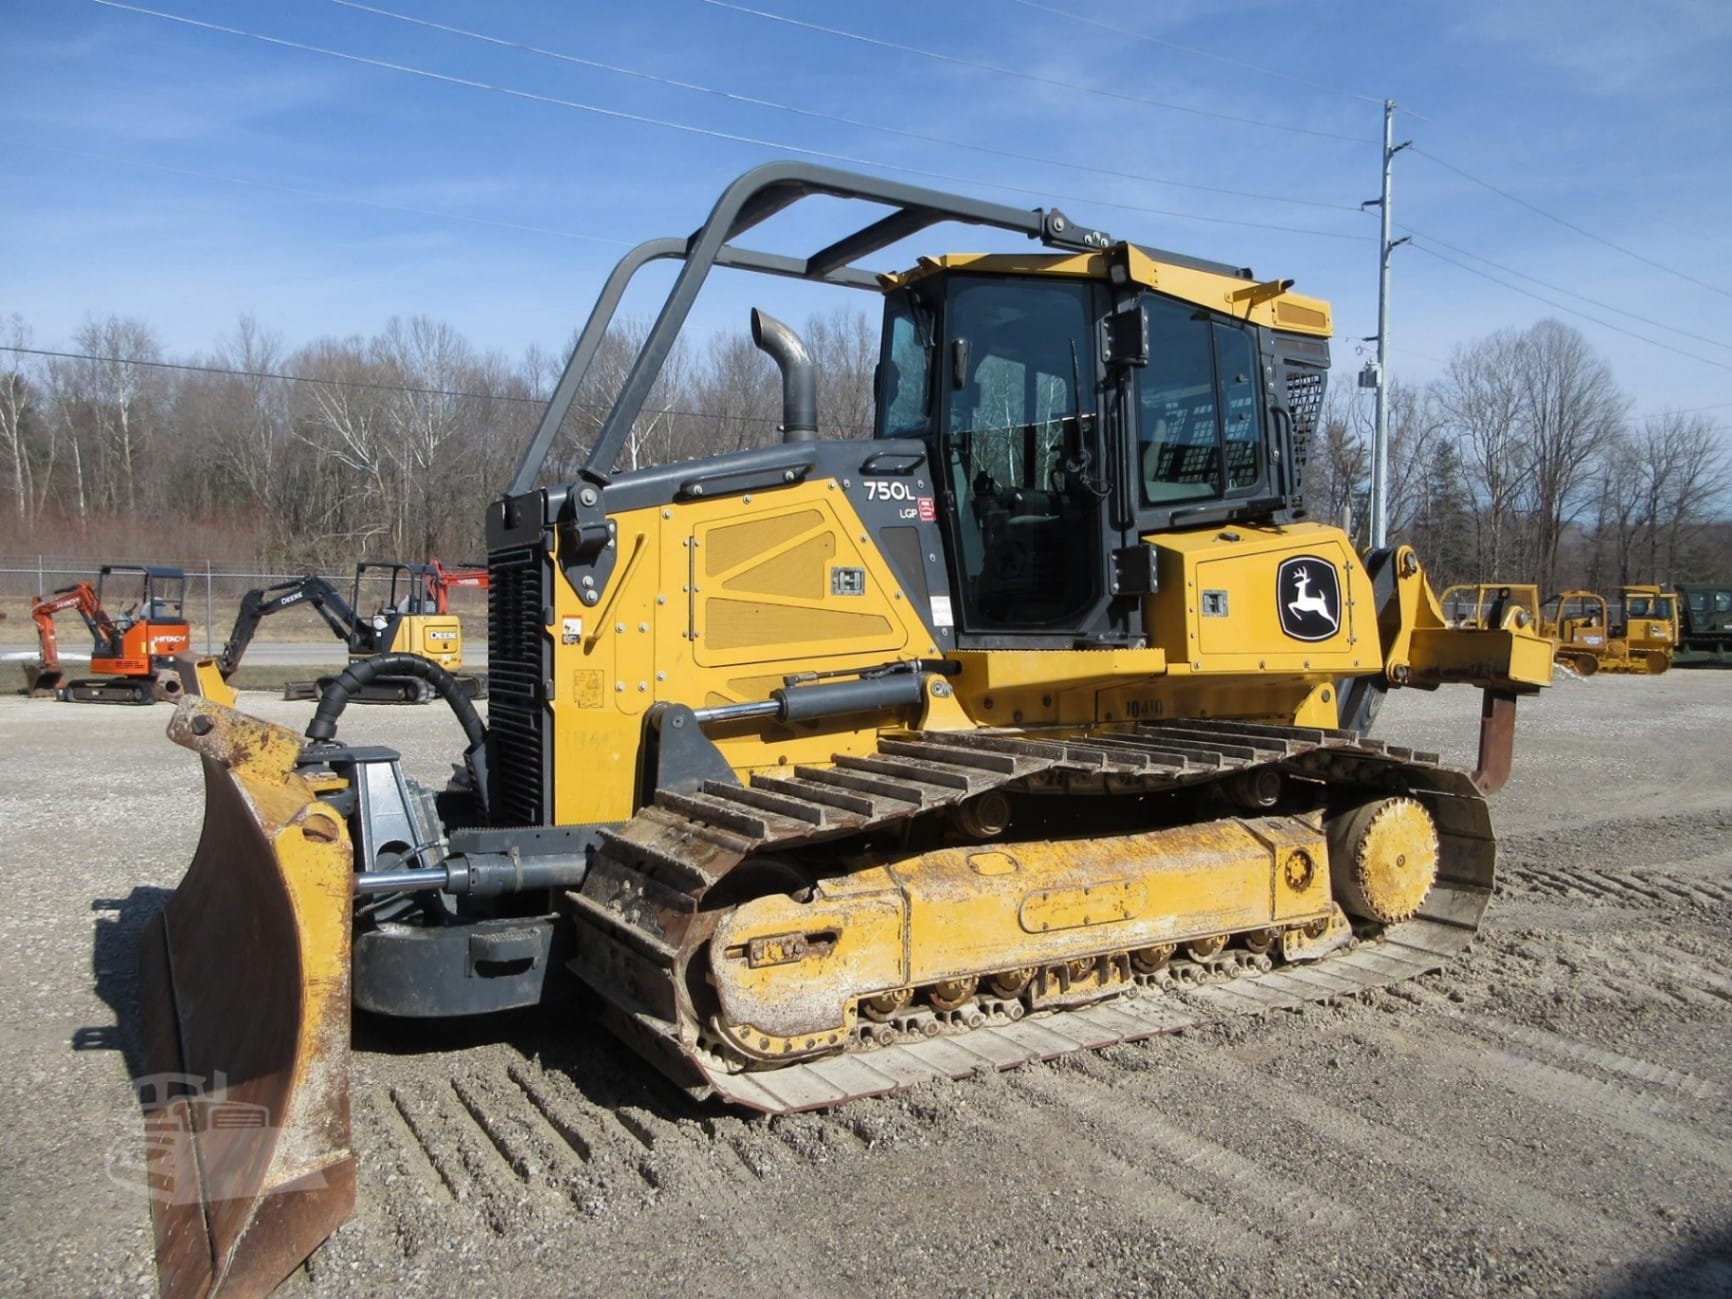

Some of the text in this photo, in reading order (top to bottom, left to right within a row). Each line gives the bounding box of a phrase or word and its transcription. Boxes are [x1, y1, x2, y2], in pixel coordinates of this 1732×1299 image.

[863, 481, 916, 500] 750L
[899, 508, 918, 519] LGP
[280, 591, 304, 605] DEERE
[430, 631, 457, 640] DEERE
